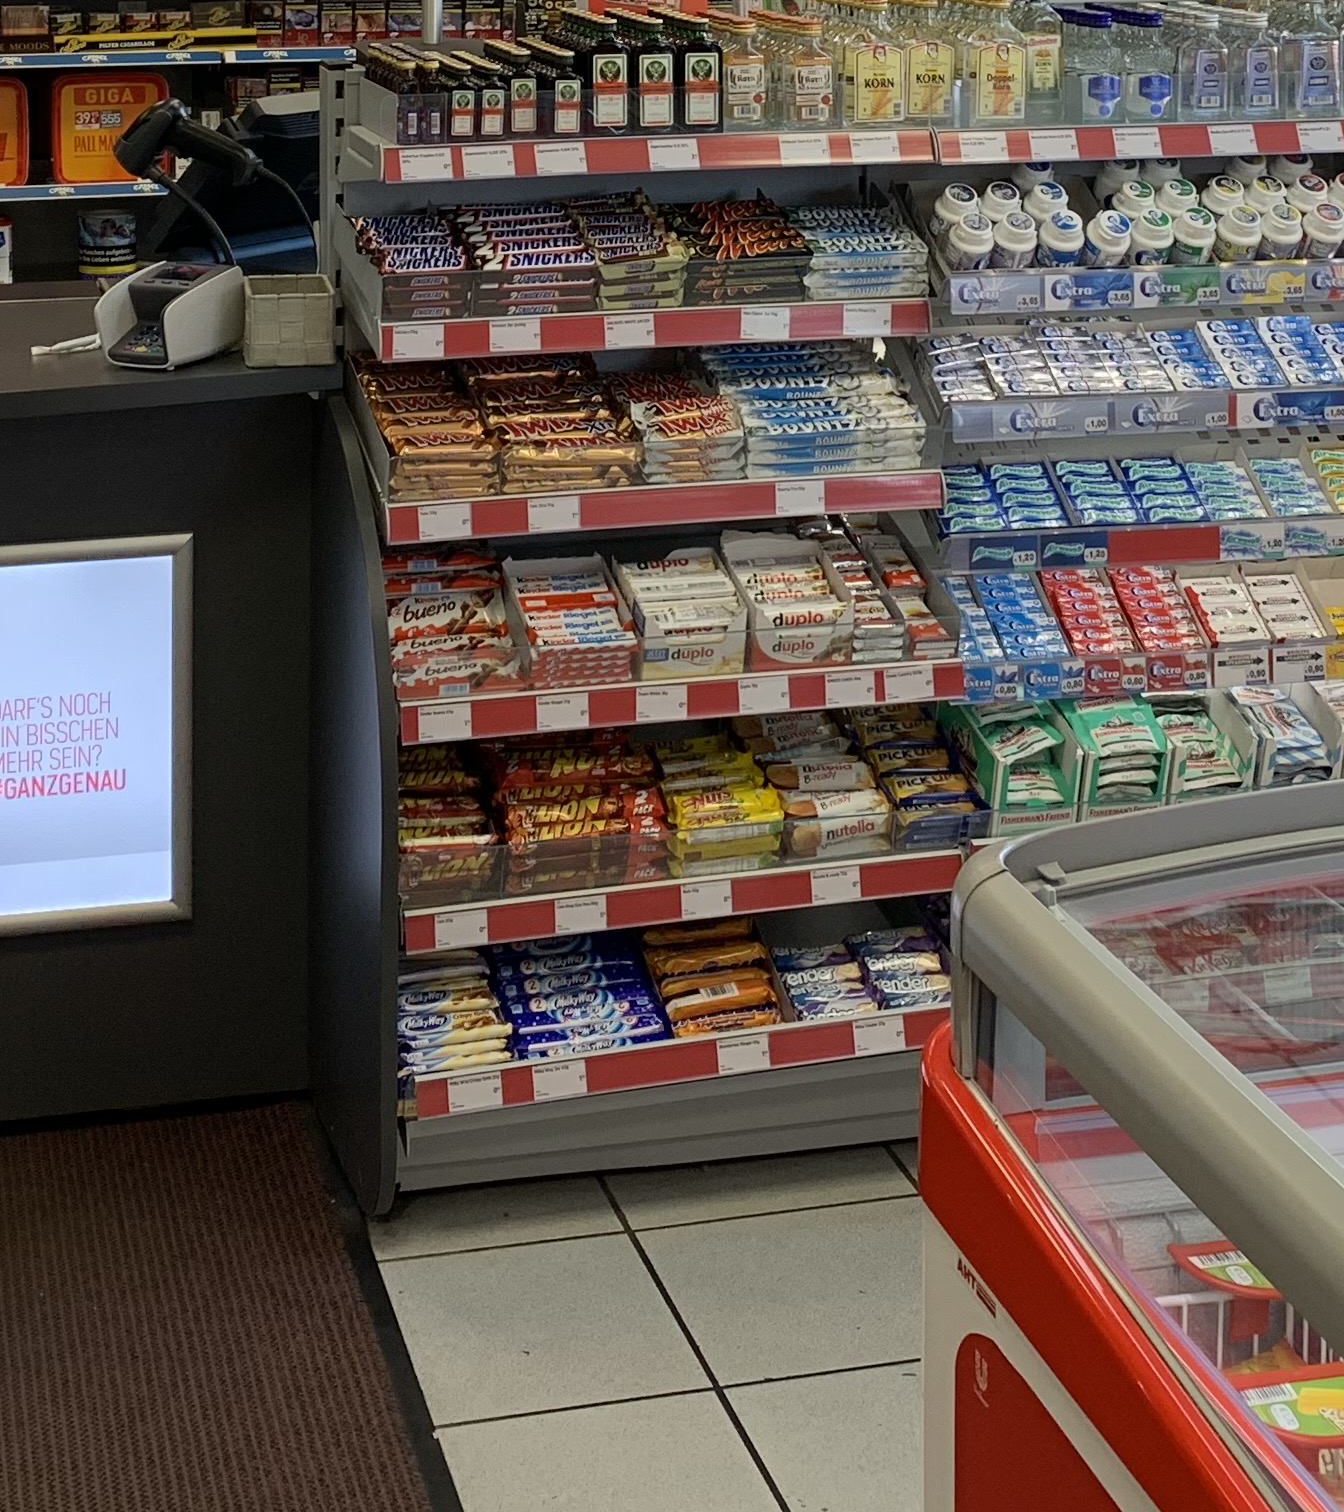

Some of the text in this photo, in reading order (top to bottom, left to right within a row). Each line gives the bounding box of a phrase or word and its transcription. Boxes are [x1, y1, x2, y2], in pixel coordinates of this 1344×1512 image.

[865, 78, 894, 89] KORN
[85, 88, 137, 105] GIGA
[504, 419, 584, 439] TWIX
[403, 600, 456, 622] bueno
[773, 610, 824, 627] duplo
[59, 691, 111, 718] NOCH
[25, 718, 119, 747] BISSCHEN
[49, 745, 102, 771] SEIN?
[535, 797, 603, 823] LION
[1001, 812, 1070, 825] FISHERMAN'S FRIEND
[826, 819, 875, 839] nutella
